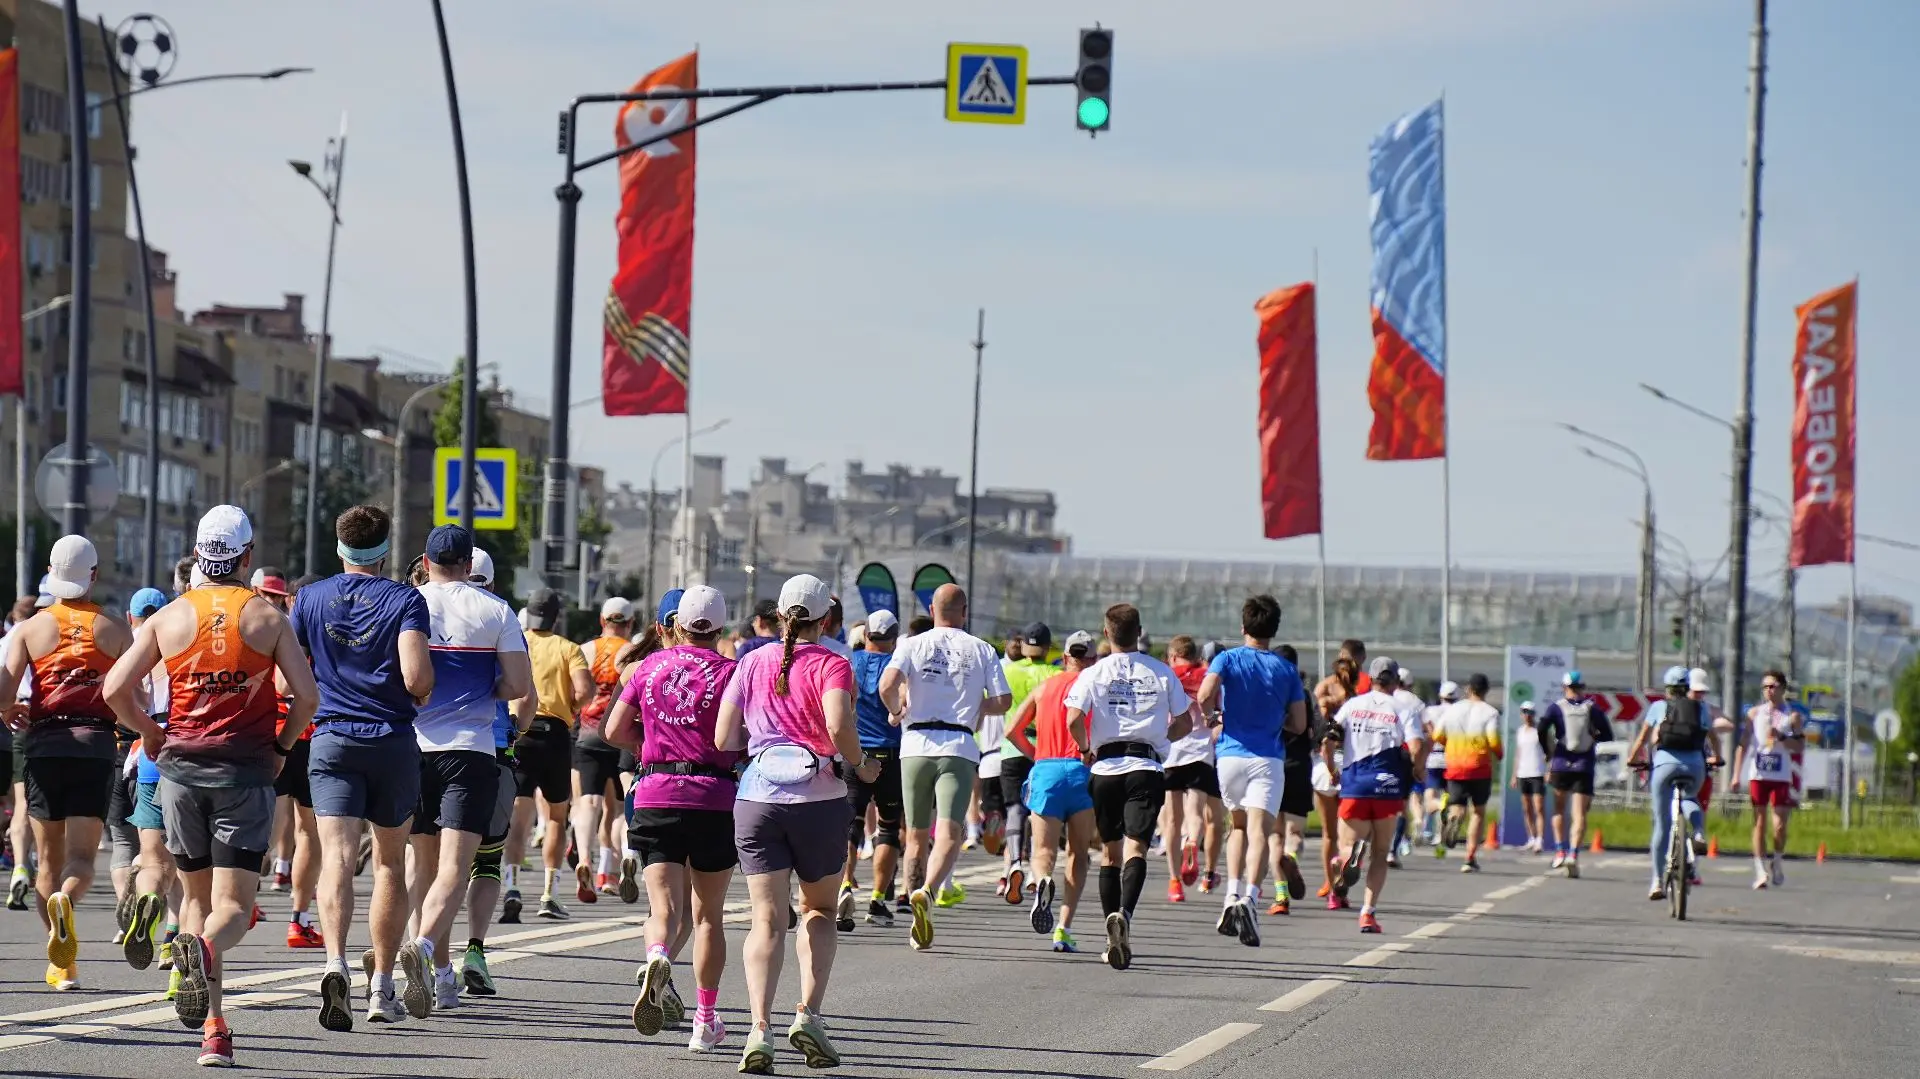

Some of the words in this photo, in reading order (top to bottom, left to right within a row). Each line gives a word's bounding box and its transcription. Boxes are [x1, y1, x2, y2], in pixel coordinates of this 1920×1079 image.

[200, 558, 232, 576] WBU
[191, 670, 249, 685] T100
[645, 660, 669, 706] БЕГОВОЕ
[679, 652, 715, 709] СООБЩЕСТВО
[657, 711, 697, 726] ВЫКСЫ
